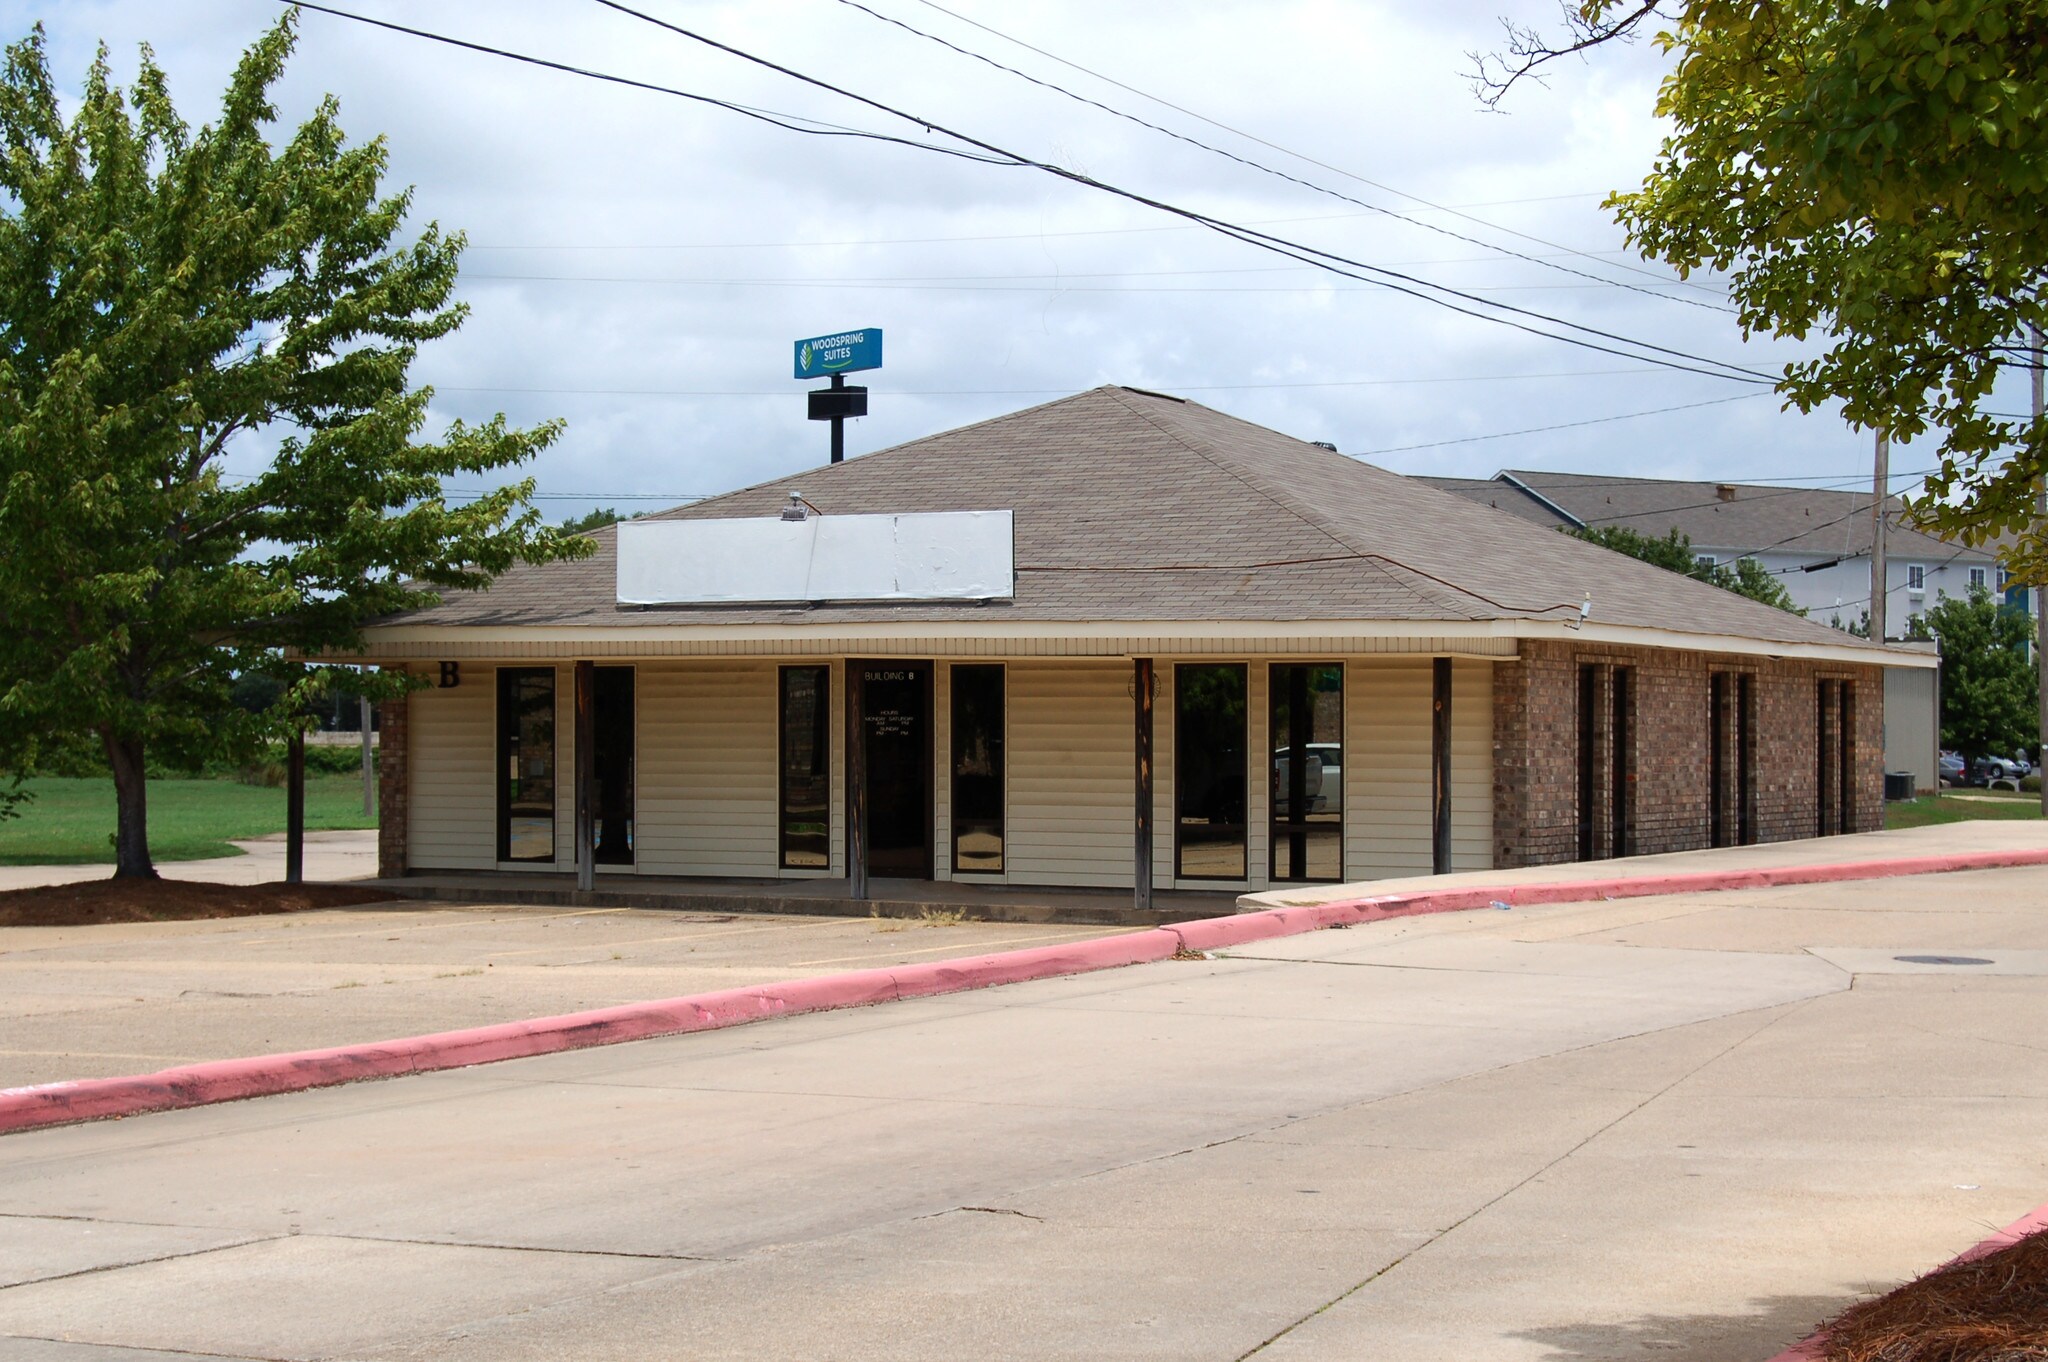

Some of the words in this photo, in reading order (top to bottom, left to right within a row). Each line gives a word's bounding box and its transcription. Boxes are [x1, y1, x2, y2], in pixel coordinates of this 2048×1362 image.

[811, 332, 864, 350] WOODSPRING
[824, 347, 851, 361] SUITES
[438, 661, 460, 688] B
[864, 671, 905, 681] BUILDING
